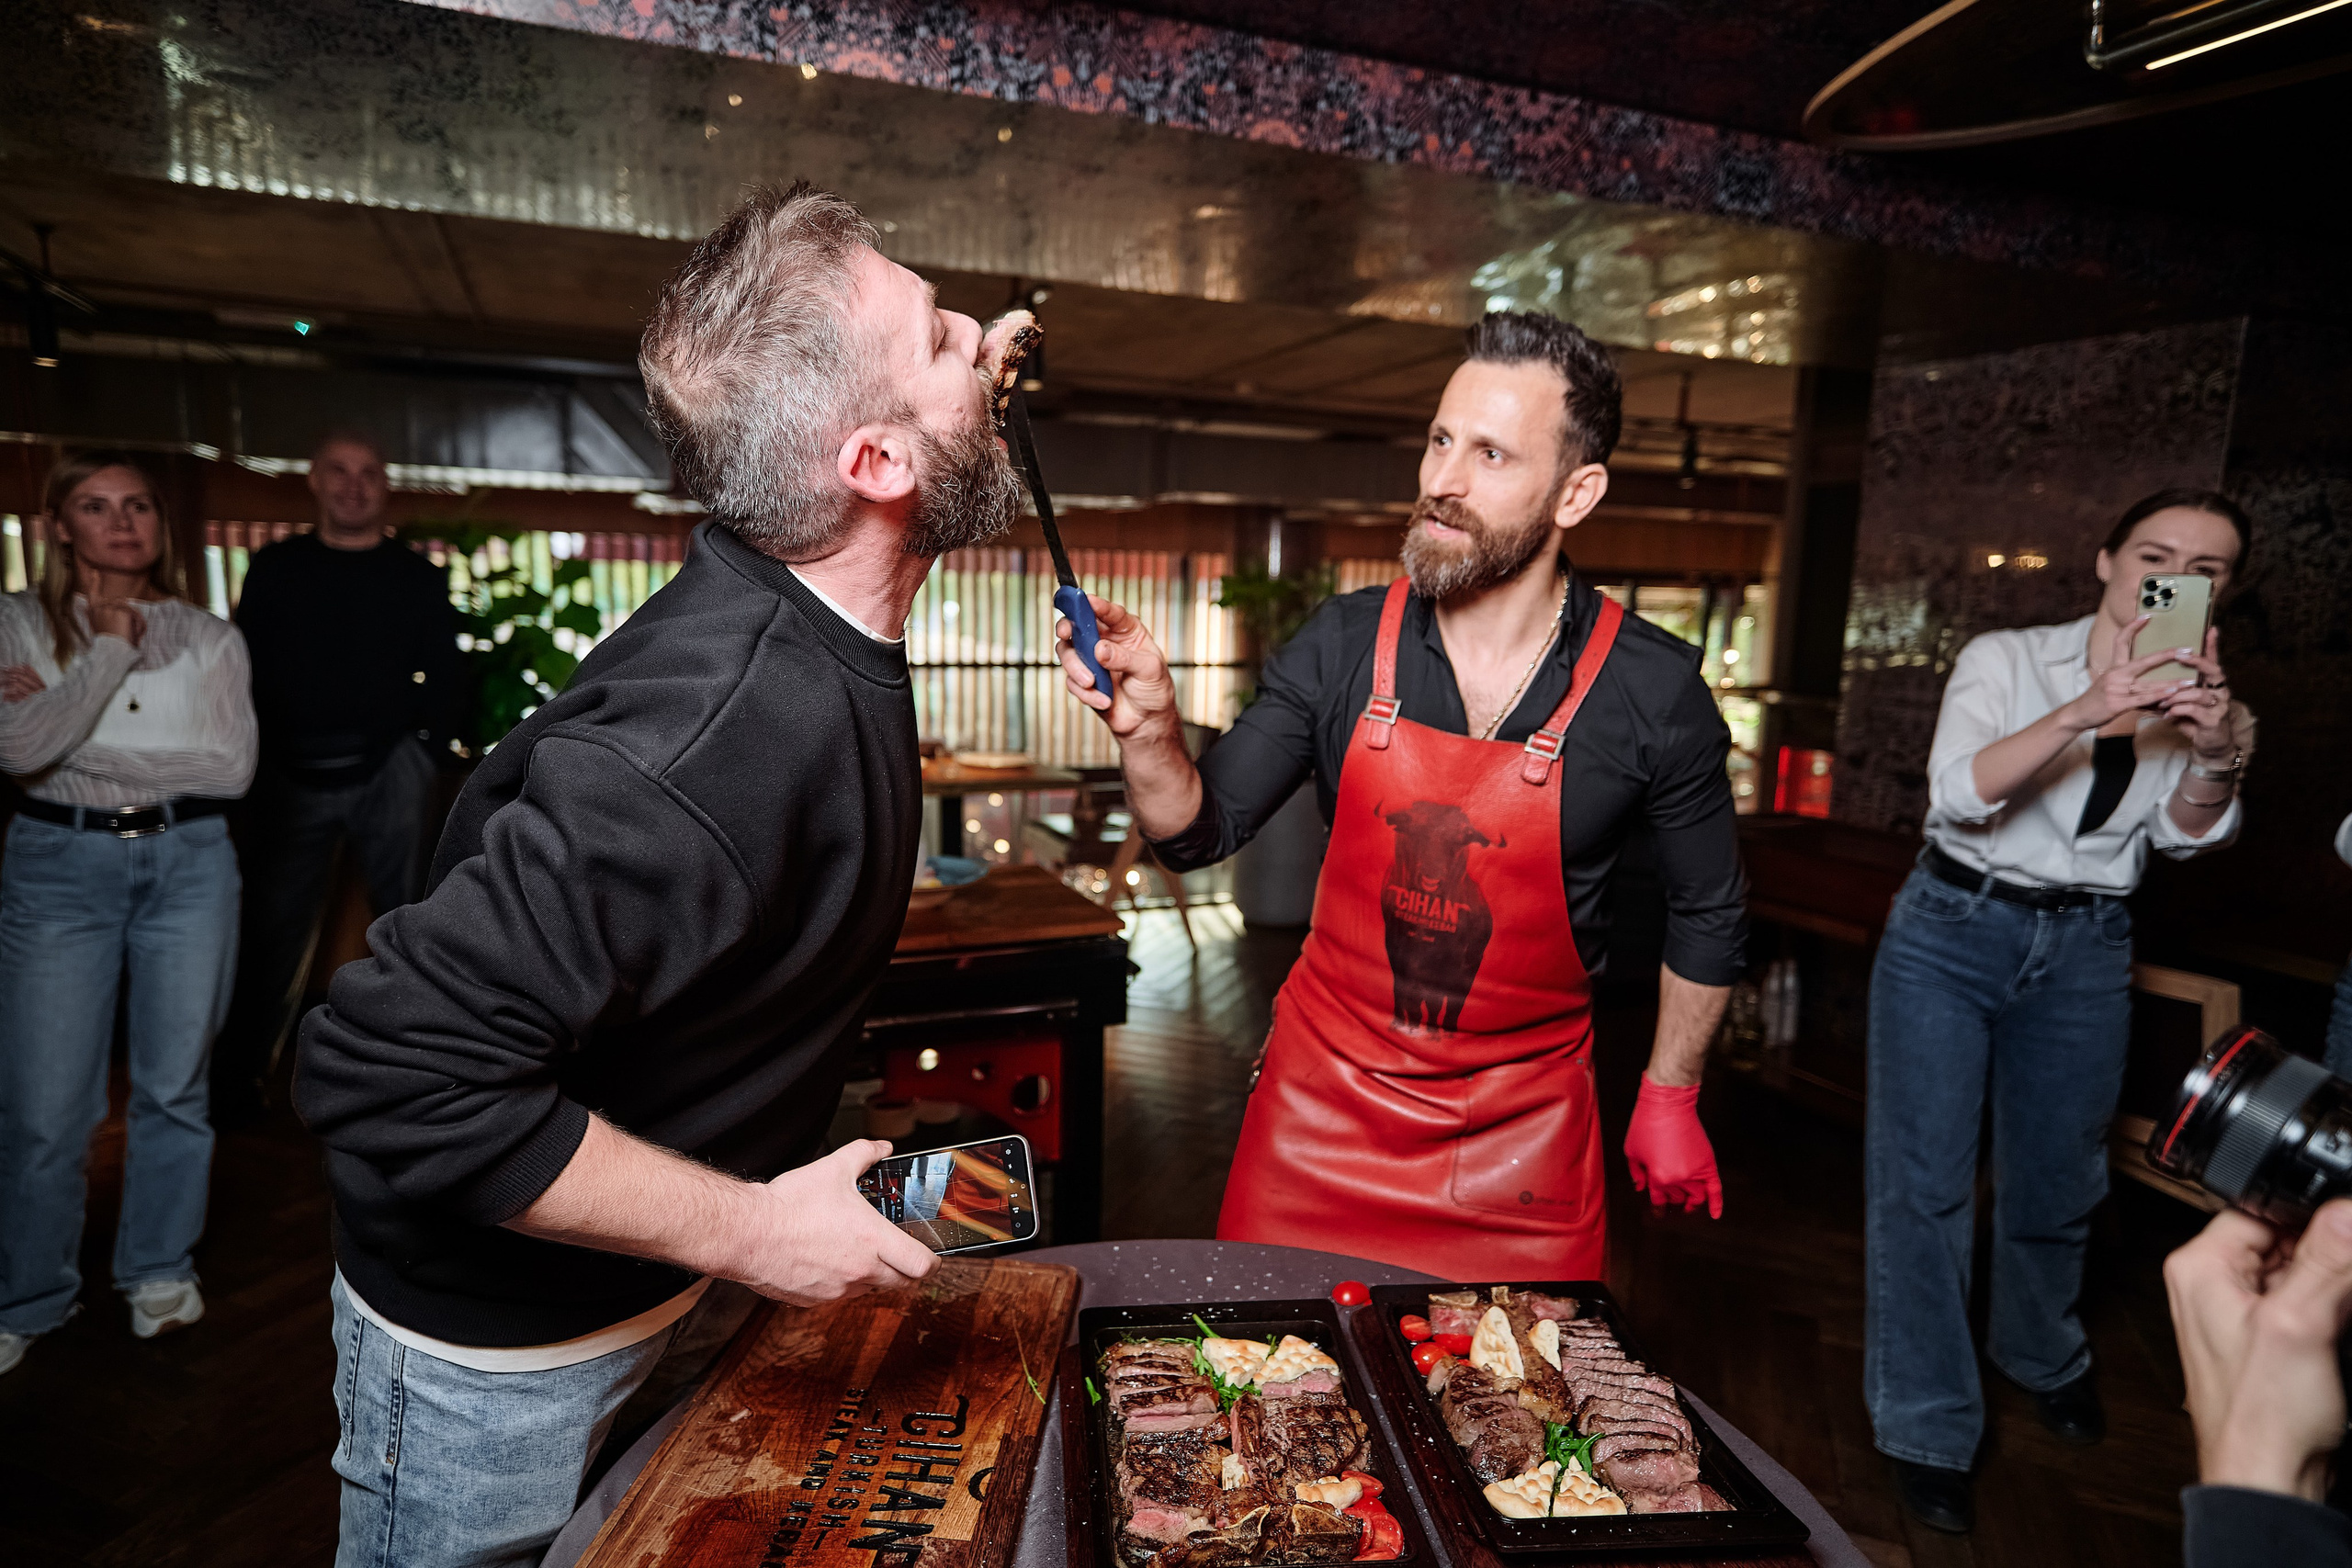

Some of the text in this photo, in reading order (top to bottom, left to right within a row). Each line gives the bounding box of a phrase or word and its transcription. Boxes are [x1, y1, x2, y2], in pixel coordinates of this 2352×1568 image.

[1388, 885, 1470, 926] CIHAN
[823, 1388, 868, 1441] STEAK
[800, 1450, 840, 1490] AND
[818, 1426, 888, 1528] TURKISH
[847, 1393, 970, 1568] CIHAN
